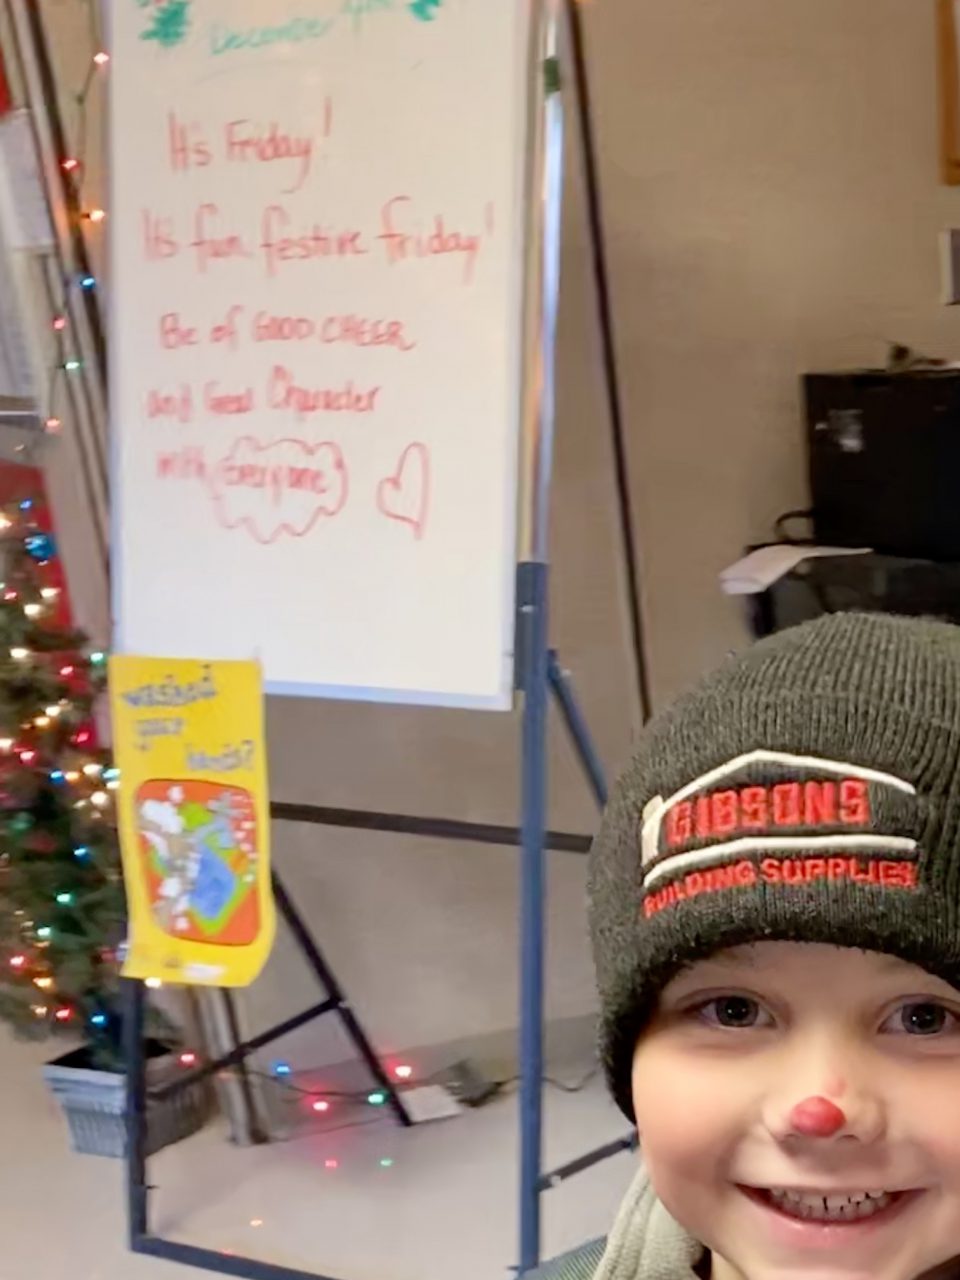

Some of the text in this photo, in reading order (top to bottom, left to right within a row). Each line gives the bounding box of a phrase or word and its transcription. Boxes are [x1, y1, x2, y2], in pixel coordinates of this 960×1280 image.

[160, 312, 200, 350] Be
[209, 304, 245, 351] of
[665, 778, 870, 845] GIBSONS
